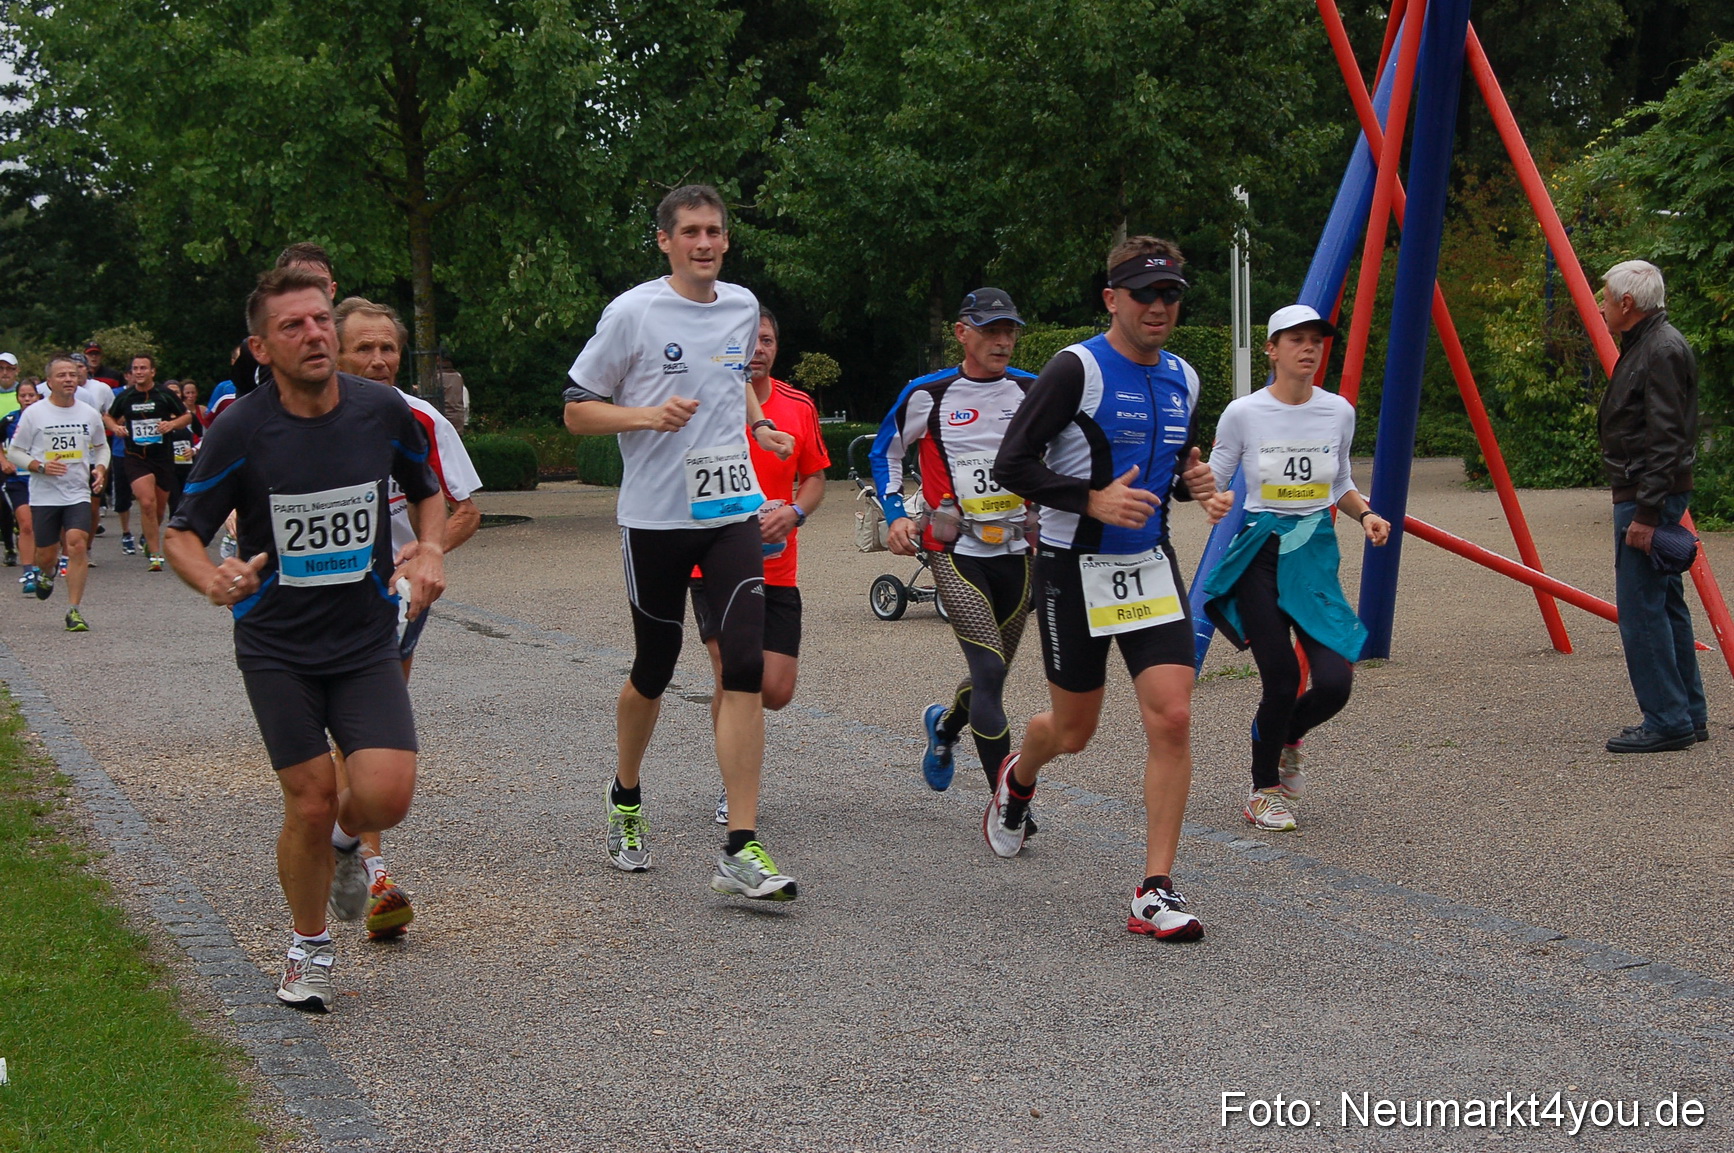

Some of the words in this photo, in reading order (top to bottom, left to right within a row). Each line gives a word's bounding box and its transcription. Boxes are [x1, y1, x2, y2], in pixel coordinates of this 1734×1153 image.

[950, 411, 971, 421] tkn
[52, 436, 76, 450] 254
[957, 459, 981, 467] PARTL
[1284, 456, 1311, 481] 49
[695, 464, 751, 497] 2168
[1277, 488, 1315, 498] Melanie
[273, 503, 310, 514] PARTL
[312, 496, 362, 511] Neumarkt
[981, 499, 1011, 512] Jürgen
[285, 508, 370, 552] 2589
[305, 556, 358, 573] Norbert
[1082, 561, 1113, 569] PARTL
[1112, 568, 1144, 600] 81
[1117, 604, 1152, 621] Ralph
